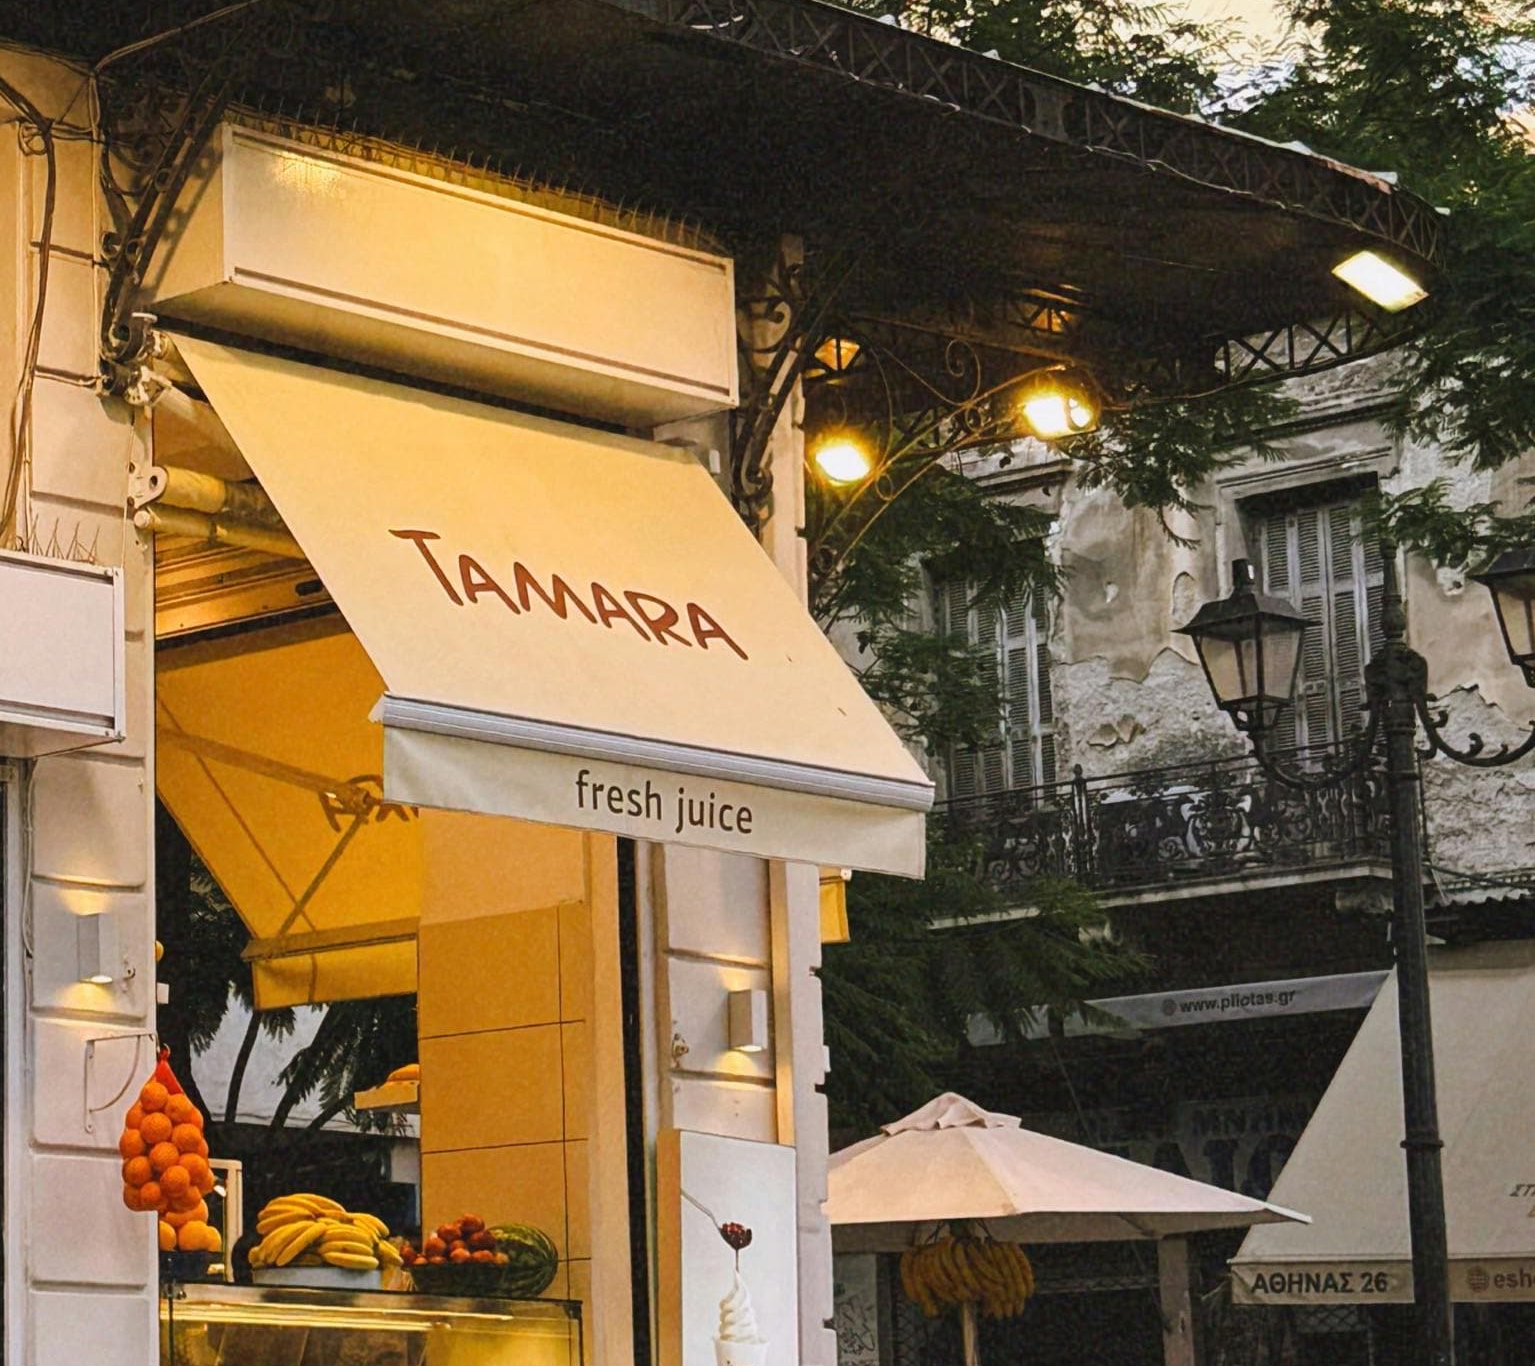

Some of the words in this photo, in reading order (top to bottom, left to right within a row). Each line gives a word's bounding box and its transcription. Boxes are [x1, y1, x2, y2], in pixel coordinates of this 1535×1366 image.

[388, 529, 749, 660] TAMARA
[575, 770, 663, 821] fresh
[675, 787, 753, 835] juice
[1251, 1272, 1354, 1295] ΑΘΗΝΑΣ
[1360, 1272, 1388, 1293] 26
[1493, 1268, 1535, 1289] esh
